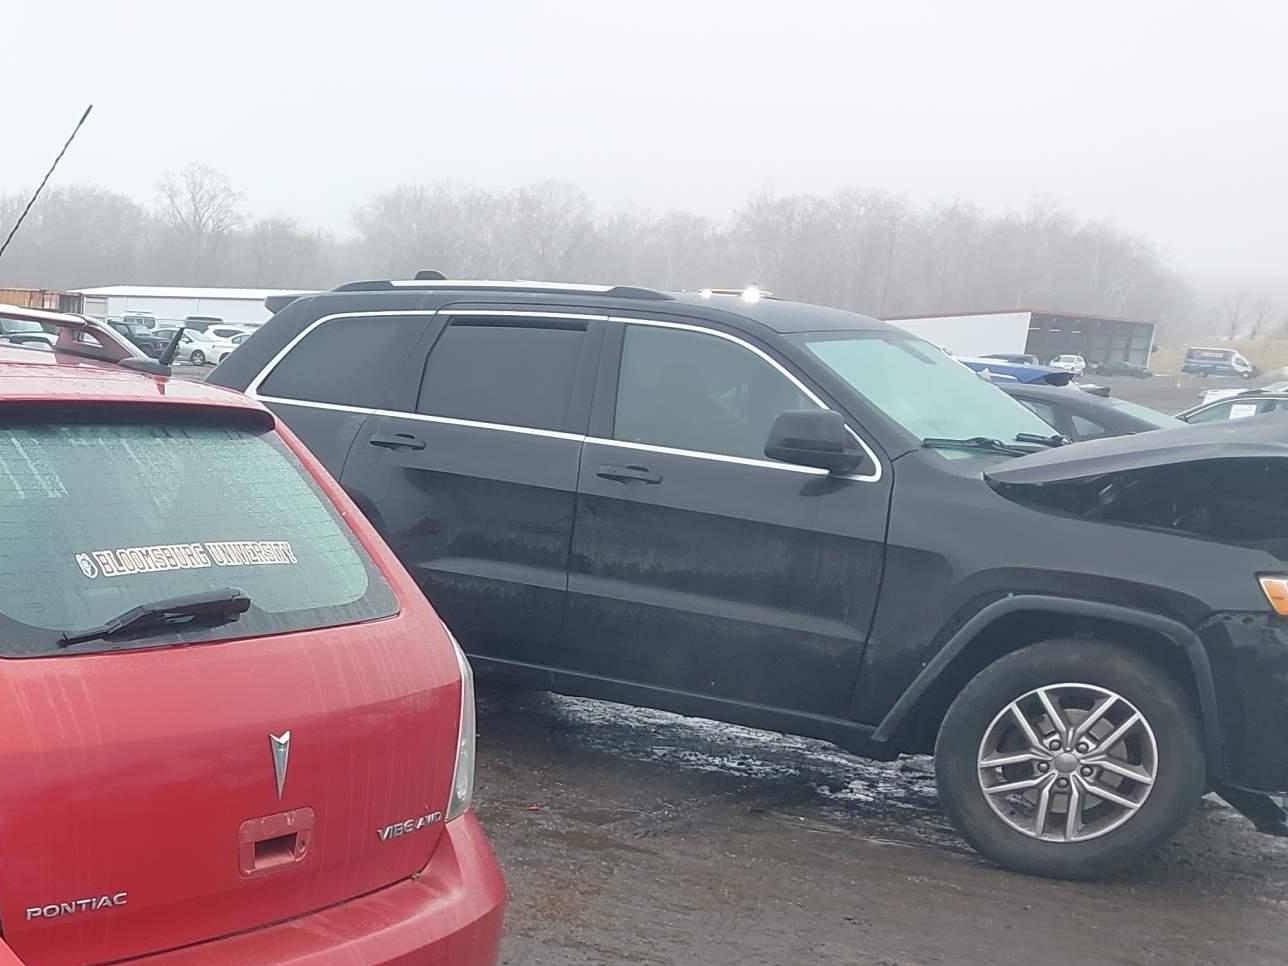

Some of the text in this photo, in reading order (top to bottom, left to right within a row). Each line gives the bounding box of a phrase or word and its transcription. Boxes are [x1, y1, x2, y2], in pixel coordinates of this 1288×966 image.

[92, 541, 297, 577] BLOOMSBURG UNIVERSITY
[377, 811, 441, 841] VIBE AWD
